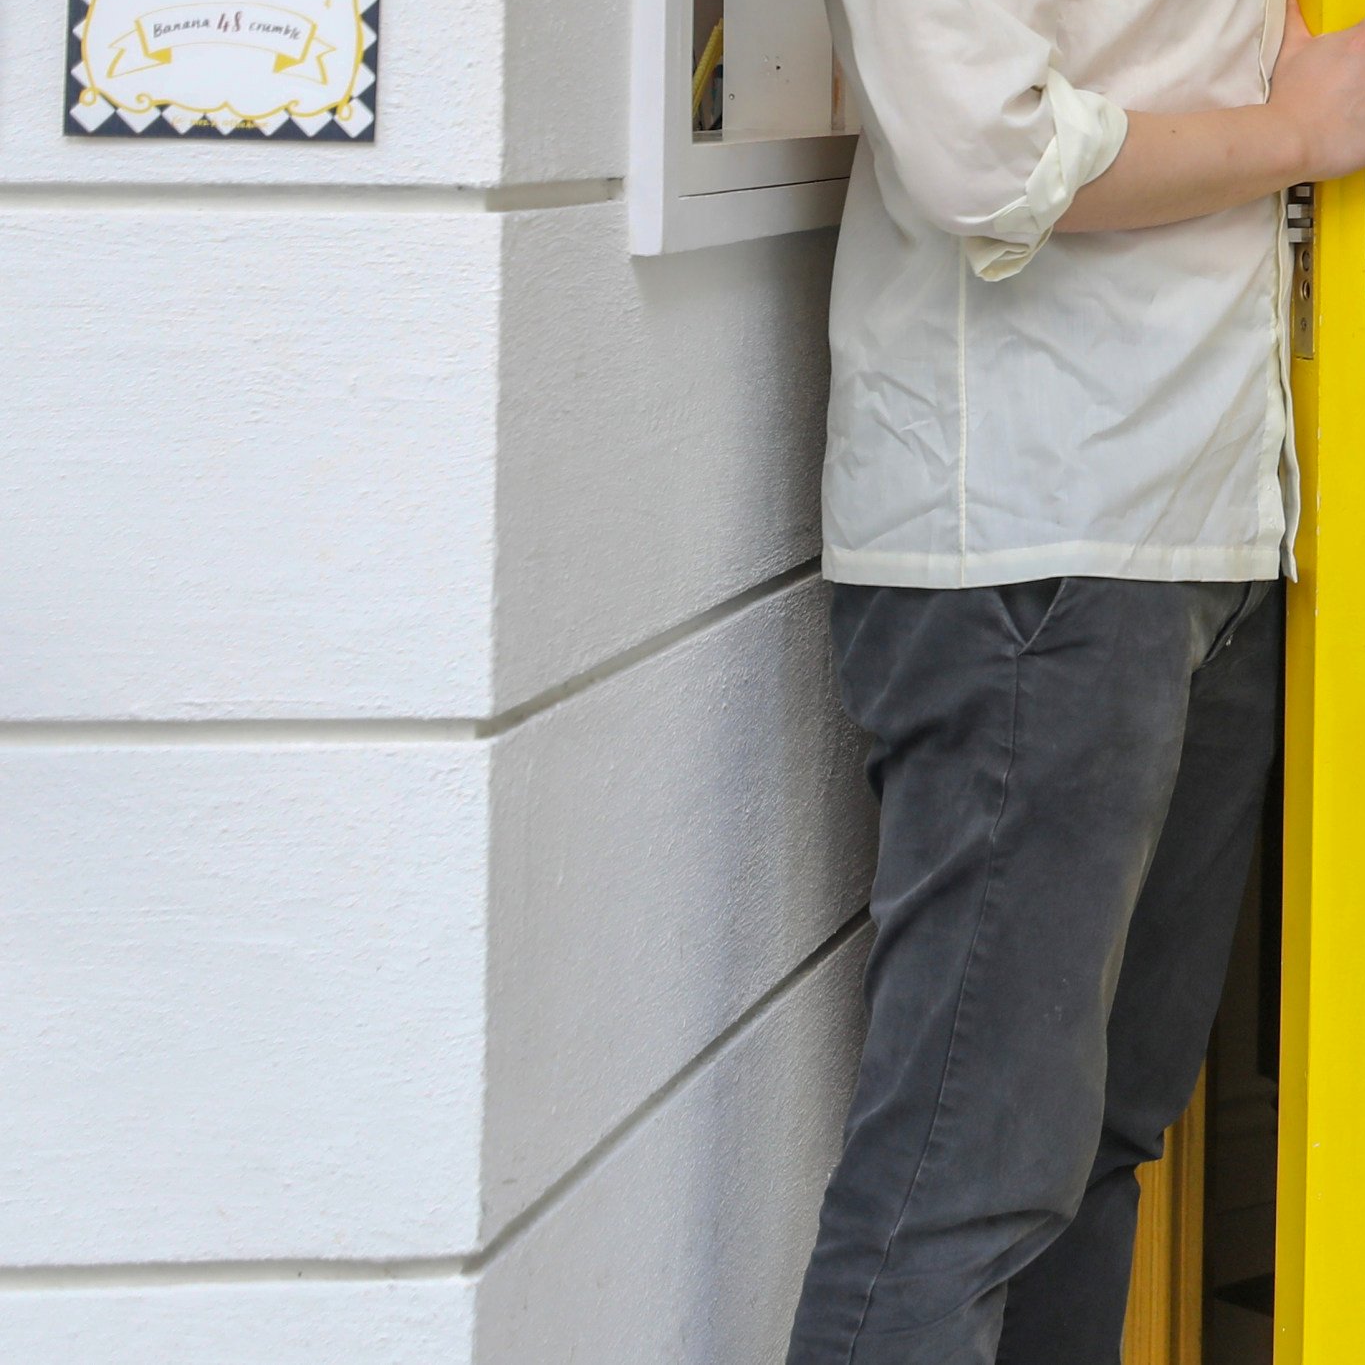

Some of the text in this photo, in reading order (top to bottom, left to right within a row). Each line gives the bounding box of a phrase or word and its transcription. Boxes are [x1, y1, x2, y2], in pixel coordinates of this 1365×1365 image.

[153, 10, 302, 40] Banana 48 crumble
